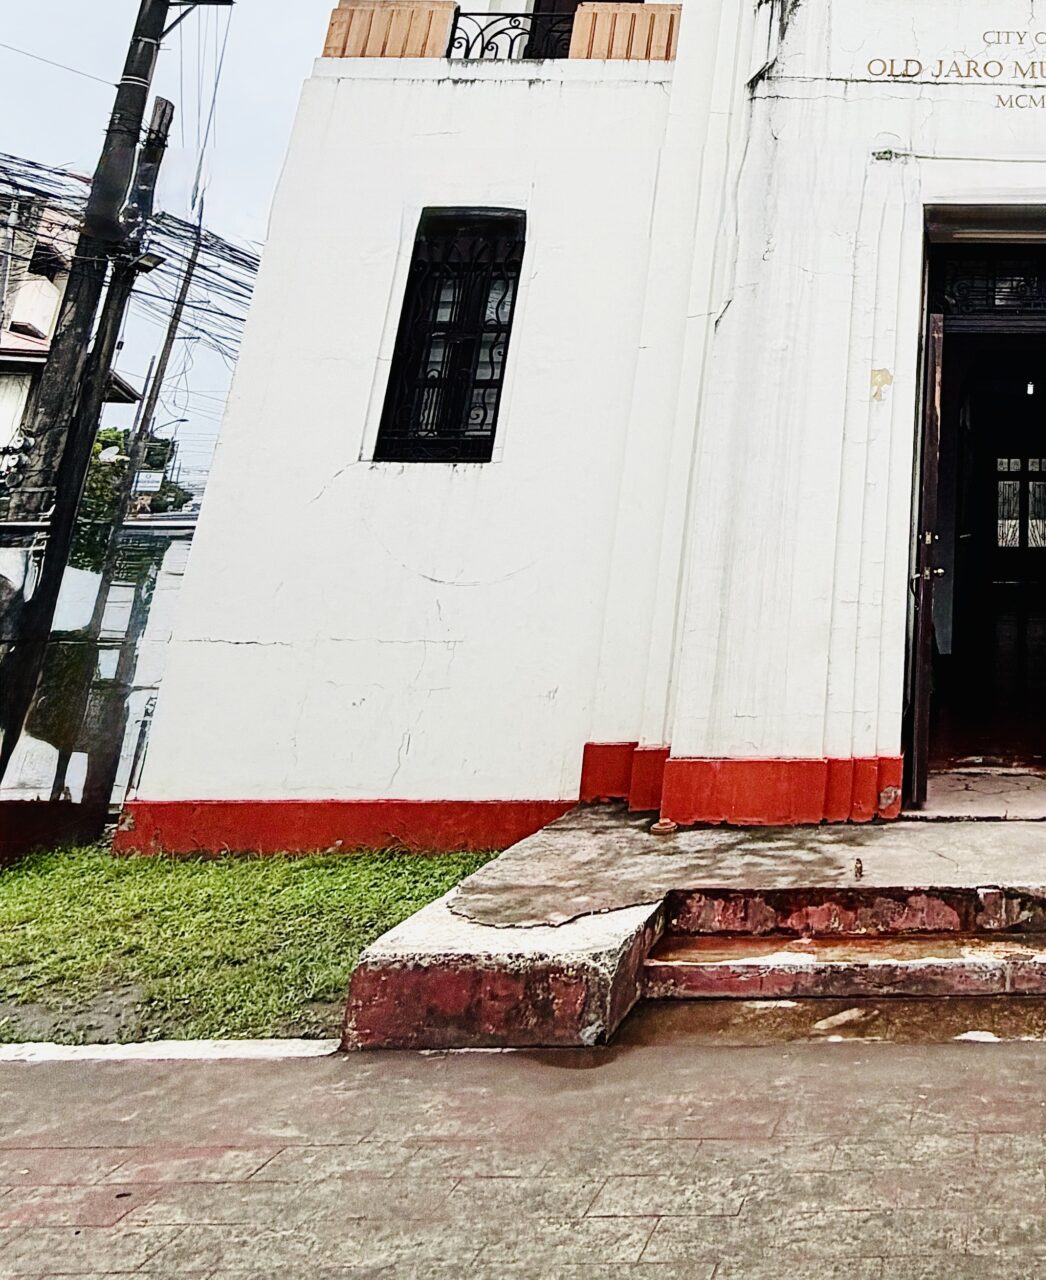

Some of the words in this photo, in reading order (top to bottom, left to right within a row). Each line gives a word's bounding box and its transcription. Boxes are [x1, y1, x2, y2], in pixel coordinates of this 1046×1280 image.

[982, 30, 1027, 45] CITY
[867, 58, 923, 78] OLD
[931, 59, 1004, 78] JARO
